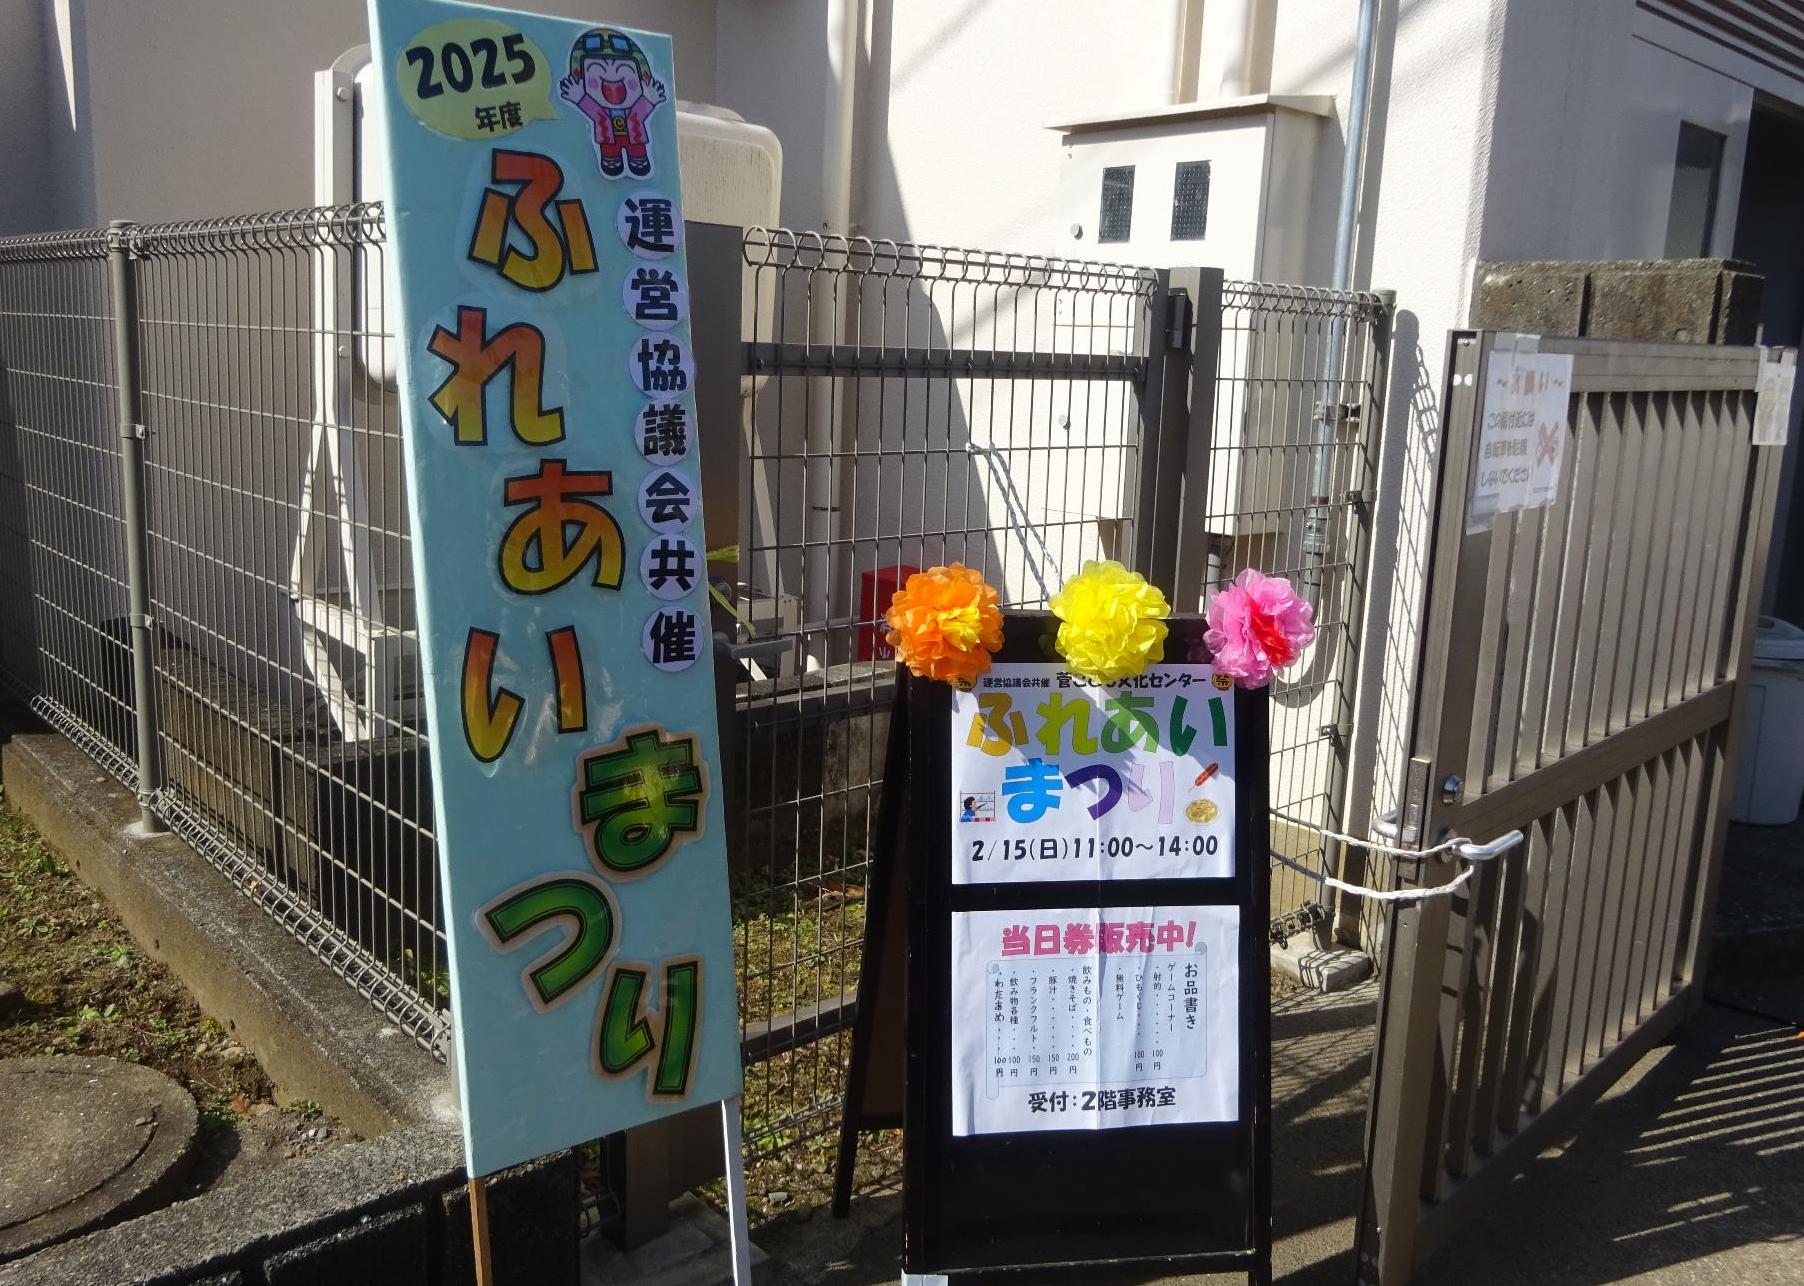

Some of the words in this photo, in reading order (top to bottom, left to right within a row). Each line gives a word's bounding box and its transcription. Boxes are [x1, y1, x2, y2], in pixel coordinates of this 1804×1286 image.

[405, 33, 536, 100] 2025
[475, 101, 524, 133] 年度
[624, 198, 697, 664] 運営協議会共催
[982, 676, 1050, 689] 運営協議会共催
[966, 691, 1228, 757] ふれあい
[1001, 757, 1175, 825] まつり
[1082, 965, 1093, 1056] 飲みもの・食べもの
[1168, 962, 1177, 1032] ゲームコーナー
[1184, 963, 1199, 1030] お品書き
